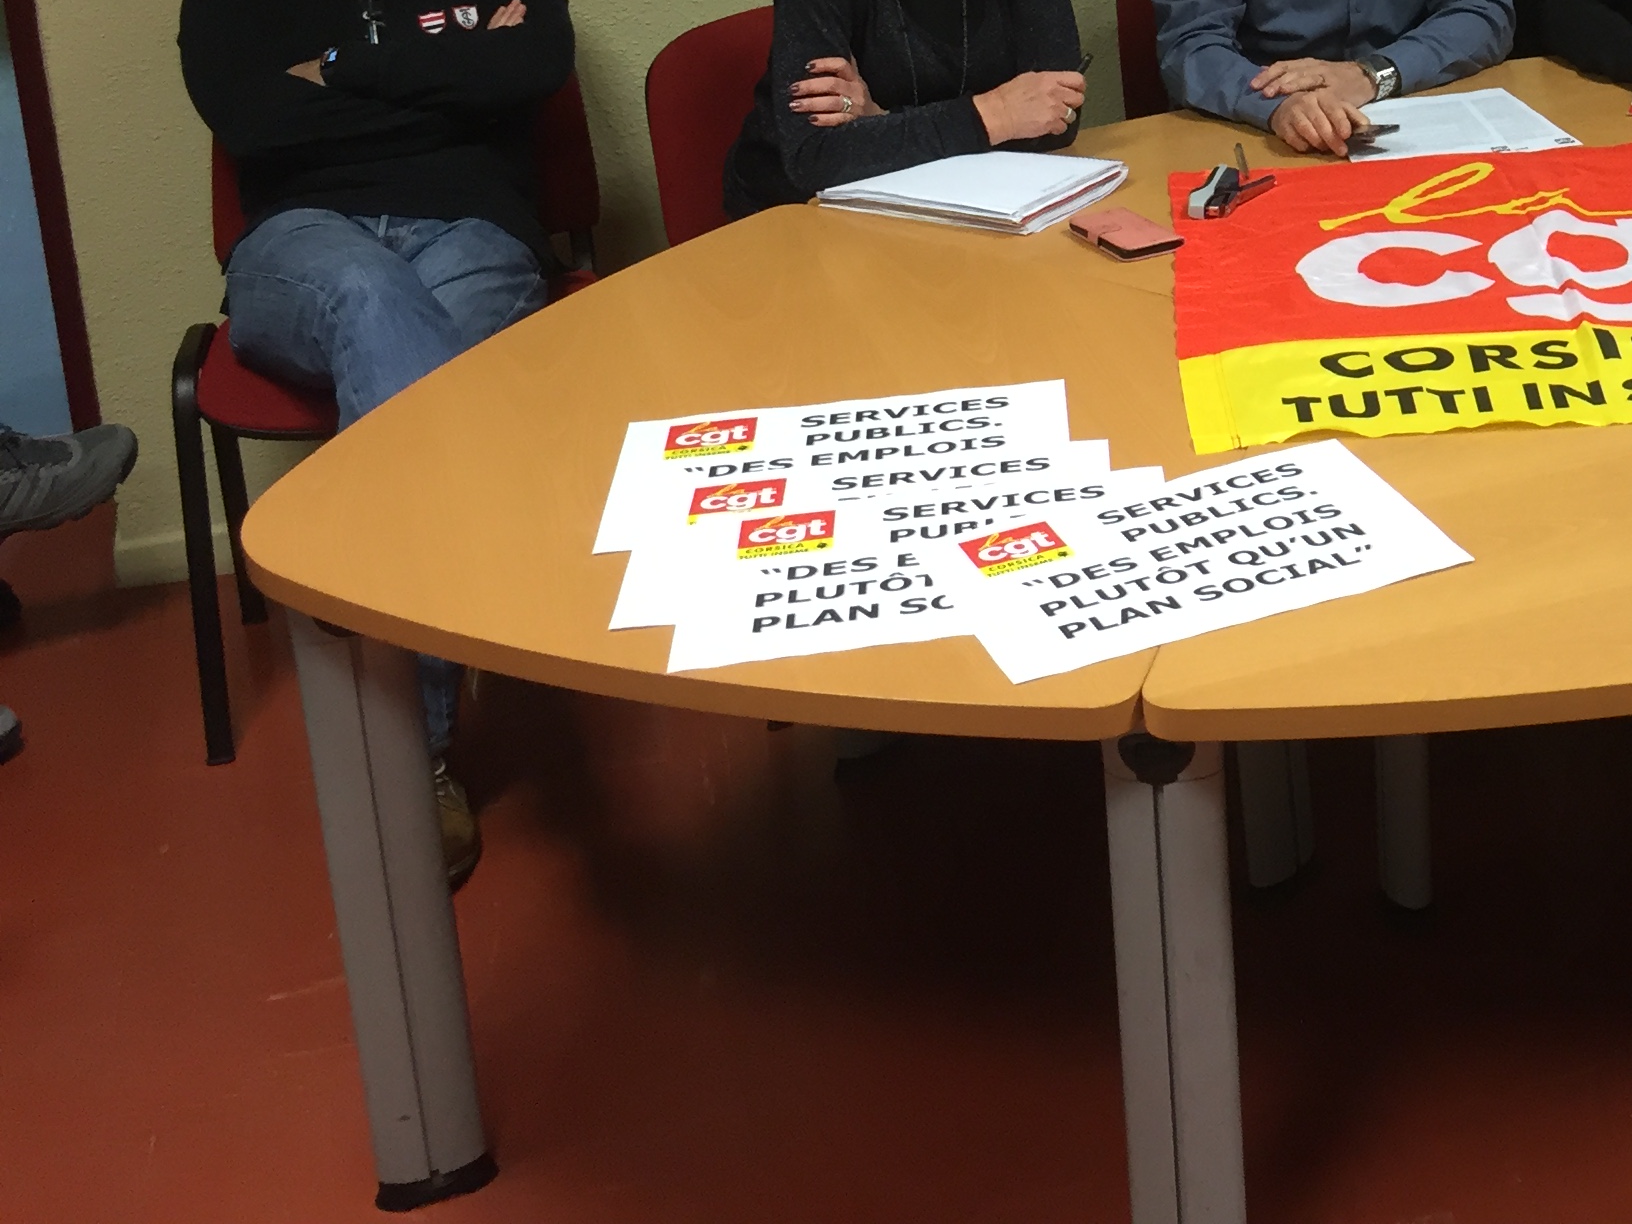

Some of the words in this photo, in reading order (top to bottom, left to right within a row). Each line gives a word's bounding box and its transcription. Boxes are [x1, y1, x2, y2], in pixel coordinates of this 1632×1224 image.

[801, 396, 1010, 428] SERVICES
[1282, 385, 1493, 423] TUTTI
[675, 425, 749, 447] cgt
[805, 416, 1003, 446] PUBLICS.
[810, 436, 1006, 466] EMPLOIS
[832, 457, 1051, 490] SERVICES
[700, 487, 777, 512] cgt
[883, 485, 1105, 522] SERVICES
[1097, 463, 1303, 525] SERVICES
[1121, 486, 1318, 542] PUBLICS.
[748, 519, 827, 544] cgt
[978, 531, 1055, 561] cgt
[1149, 504, 1342, 562] EMPLOIS
[1040, 559, 1210, 617] PLUTÔT
[1228, 523, 1366, 566] QU'UN
[752, 603, 879, 633] PLAN
[1058, 595, 1182, 639] PLAN
